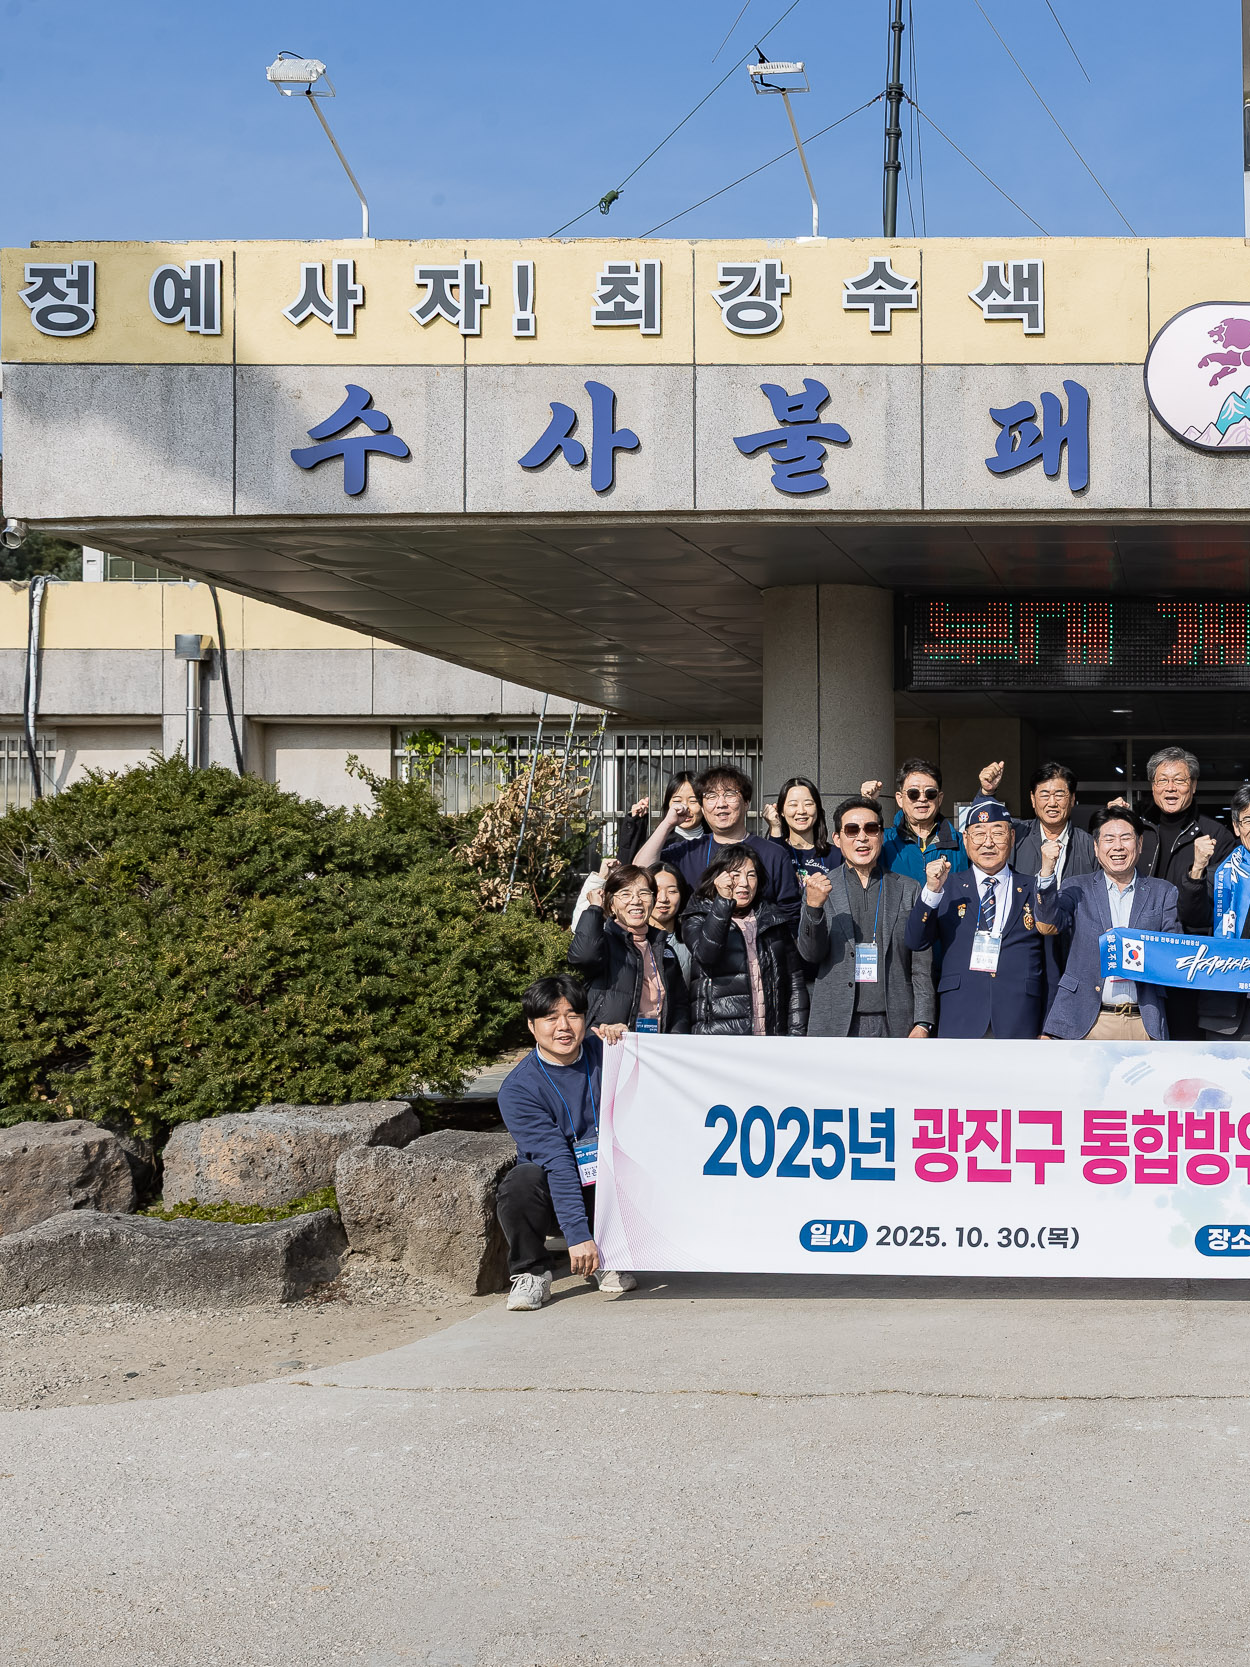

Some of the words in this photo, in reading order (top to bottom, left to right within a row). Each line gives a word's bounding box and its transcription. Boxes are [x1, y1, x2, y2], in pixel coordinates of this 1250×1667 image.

[290, 378, 1092, 496] 수사불패
[703, 1104, 895, 1181] 2025년
[912, 1108, 1066, 1185] 광진구
[810, 1223, 855, 1246] 일시
[876, 1225, 947, 1247] 2025.
[955, 1227, 988, 1247] 10.
[997, 1227, 1080, 1249] 30.(목)
